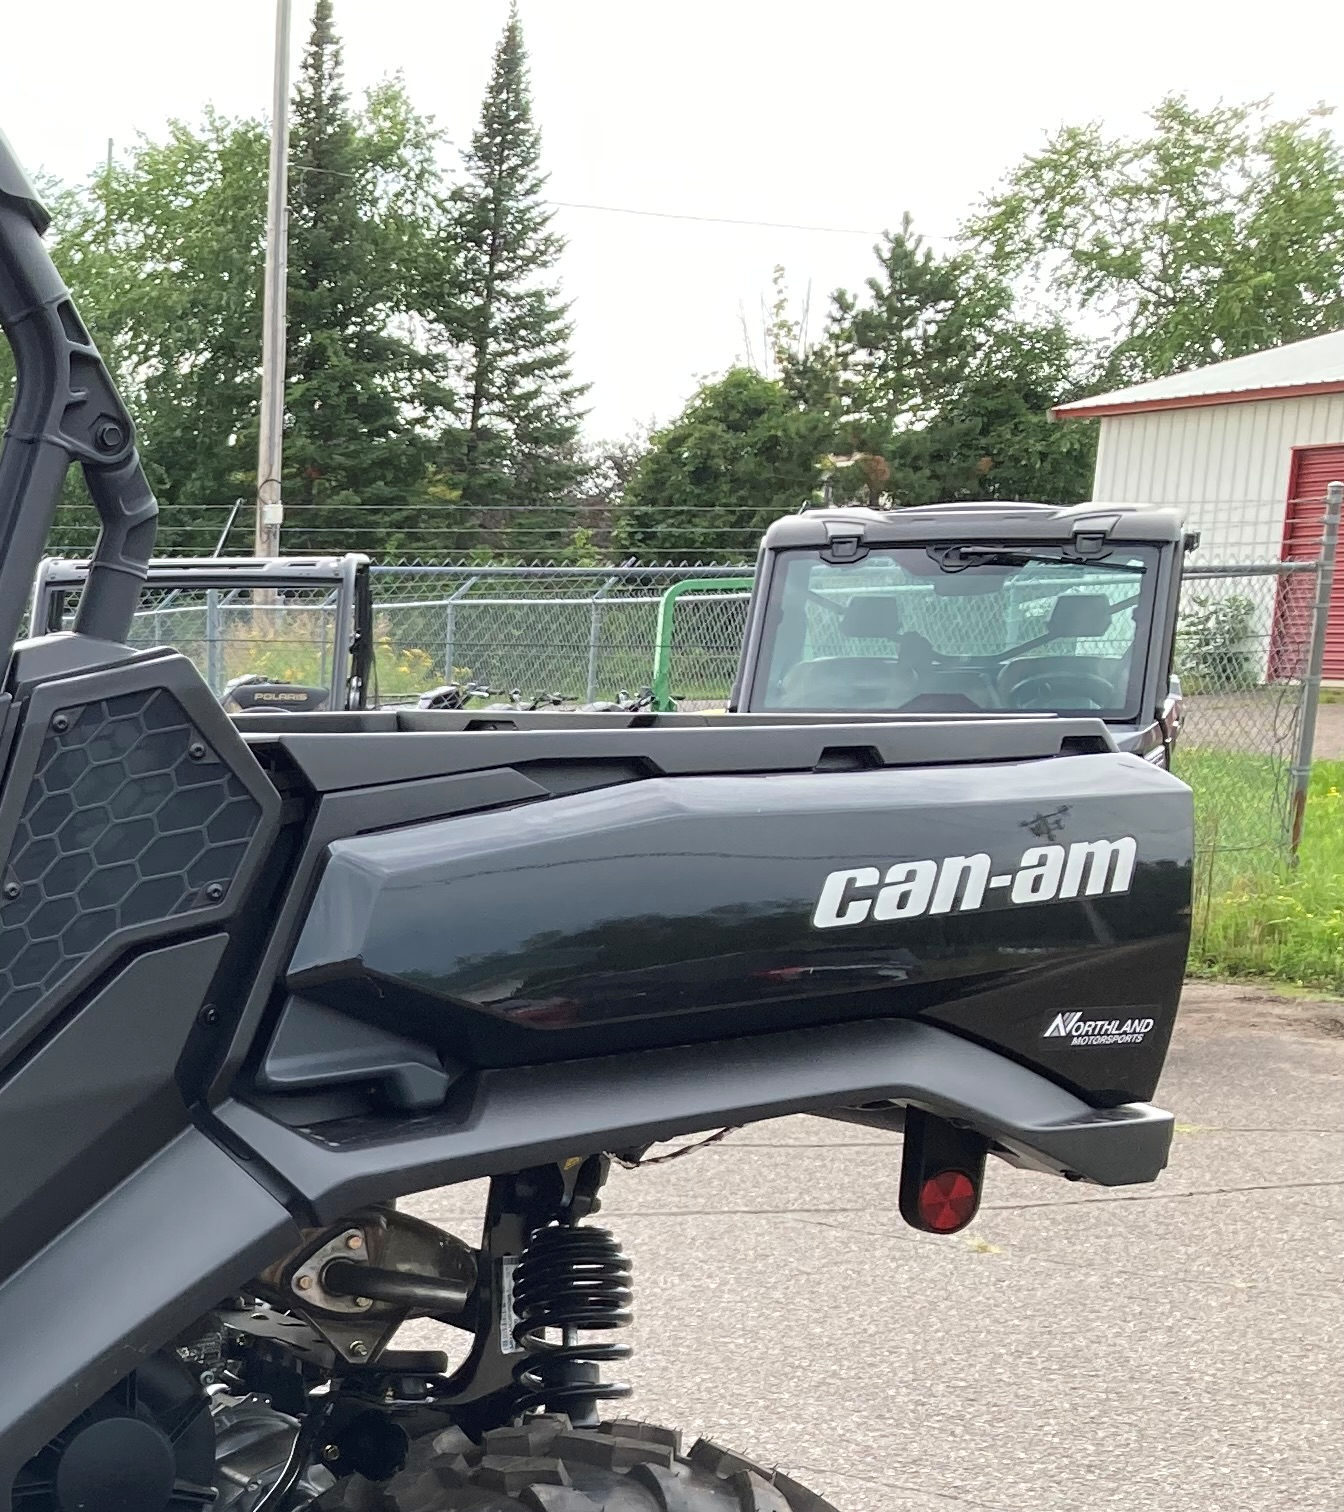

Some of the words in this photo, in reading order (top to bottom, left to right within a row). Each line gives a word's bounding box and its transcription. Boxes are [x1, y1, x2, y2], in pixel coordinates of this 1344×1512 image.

[254, 692, 308, 701] POLARIS
[813, 836, 1138, 929] can-am
[1043, 1011, 1154, 1037] NORTHLAND
[1071, 1033, 1144, 1046] MOTORSPORTS
